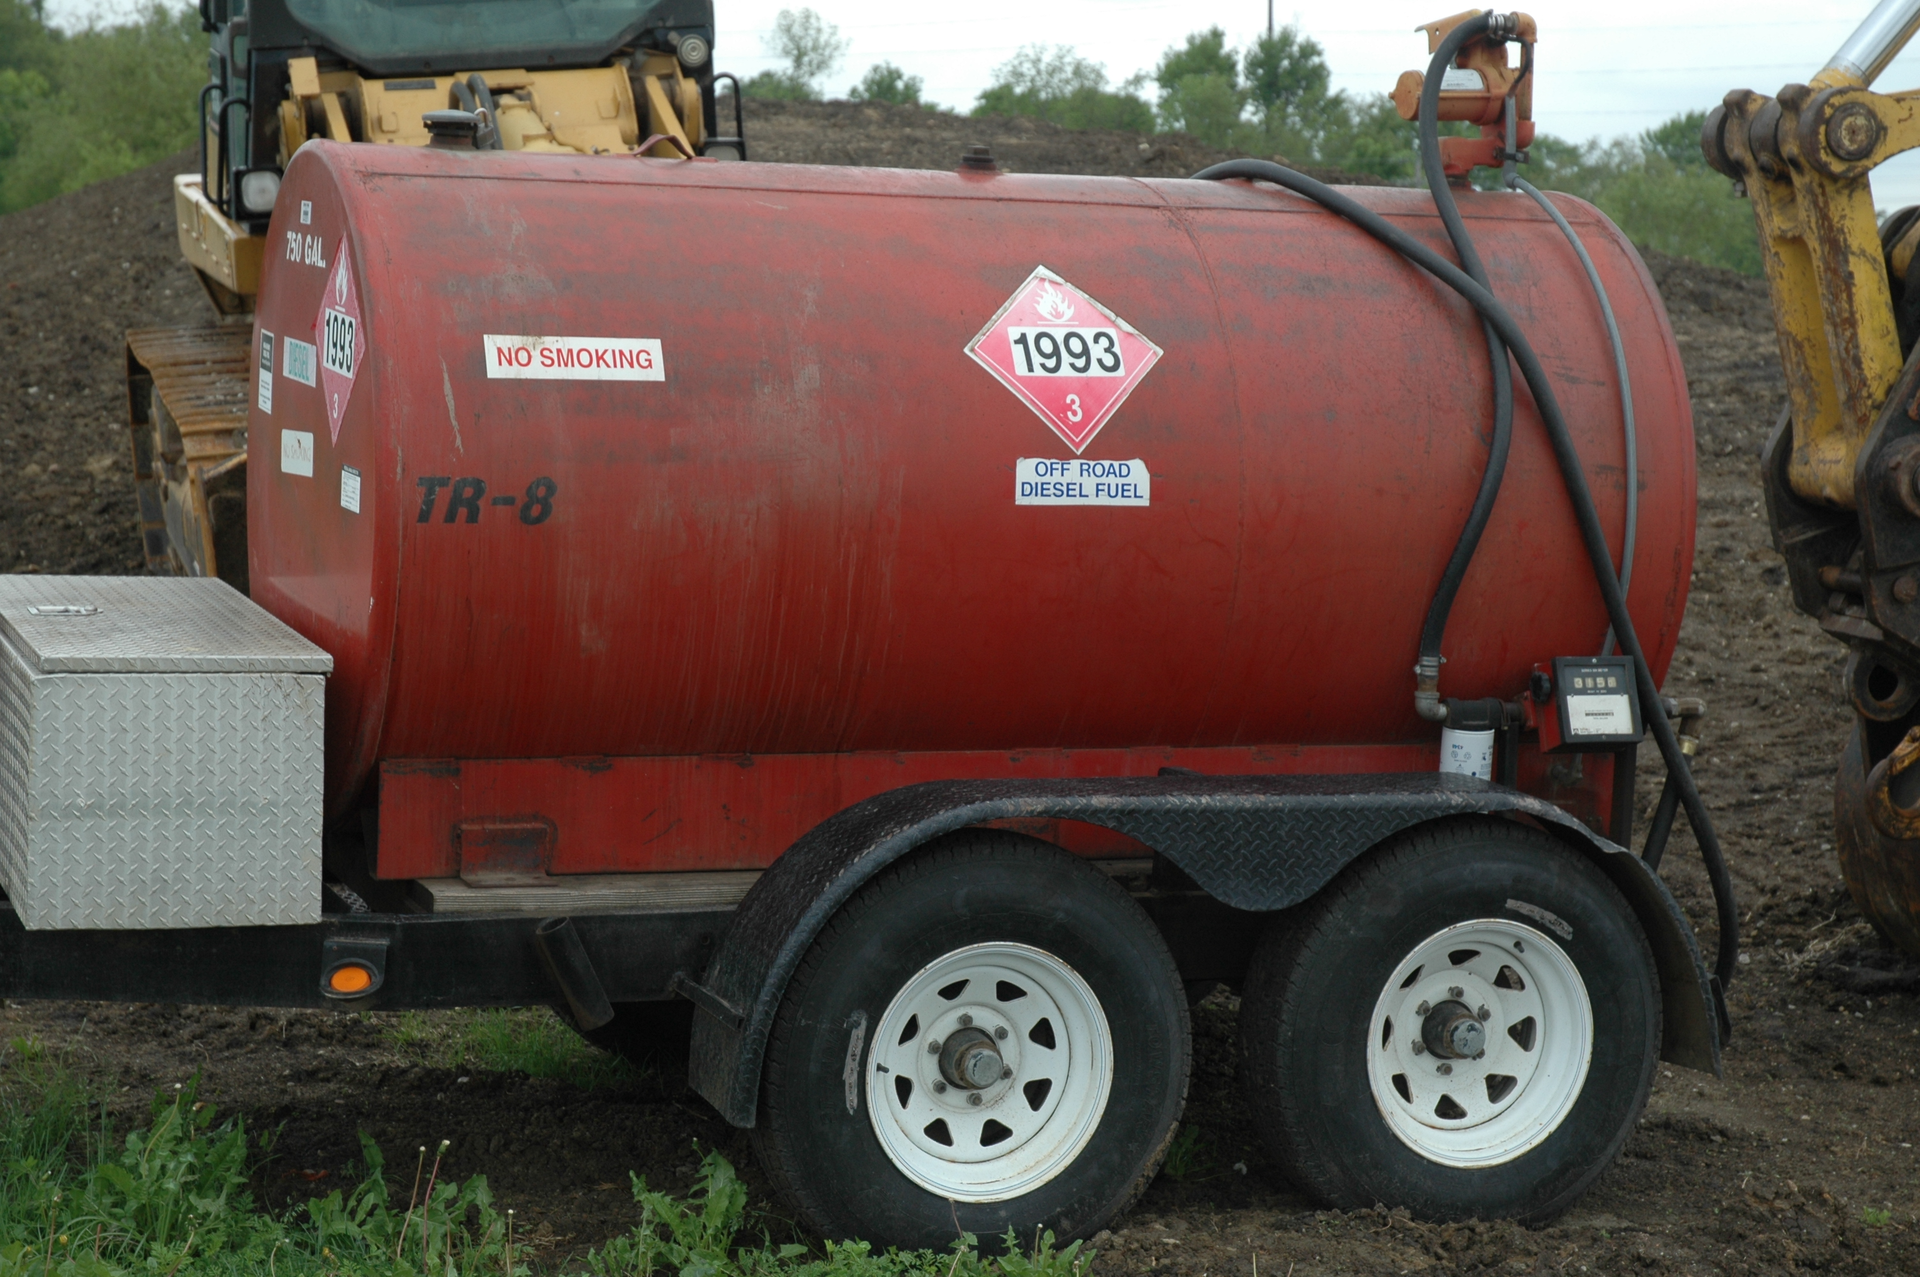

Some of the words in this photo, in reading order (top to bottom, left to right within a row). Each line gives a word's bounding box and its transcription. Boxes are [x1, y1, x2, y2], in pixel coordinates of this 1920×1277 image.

[286, 231, 302, 262] 750
[304, 234, 326, 268] GAL.
[325, 311, 354, 373] 1993
[1013, 331, 1121, 374] 1993
[497, 346, 533, 367] NO
[539, 347, 653, 369] SMOKING
[333, 393, 339, 419] 3
[1065, 394, 1083, 422] 3
[1034, 461, 1071, 477] OFF
[1079, 462, 1131, 478] ROAD
[416, 476, 558, 525] TR-8
[1021, 482, 1089, 498] DIESEL
[1095, 483, 1143, 498] FUEL
